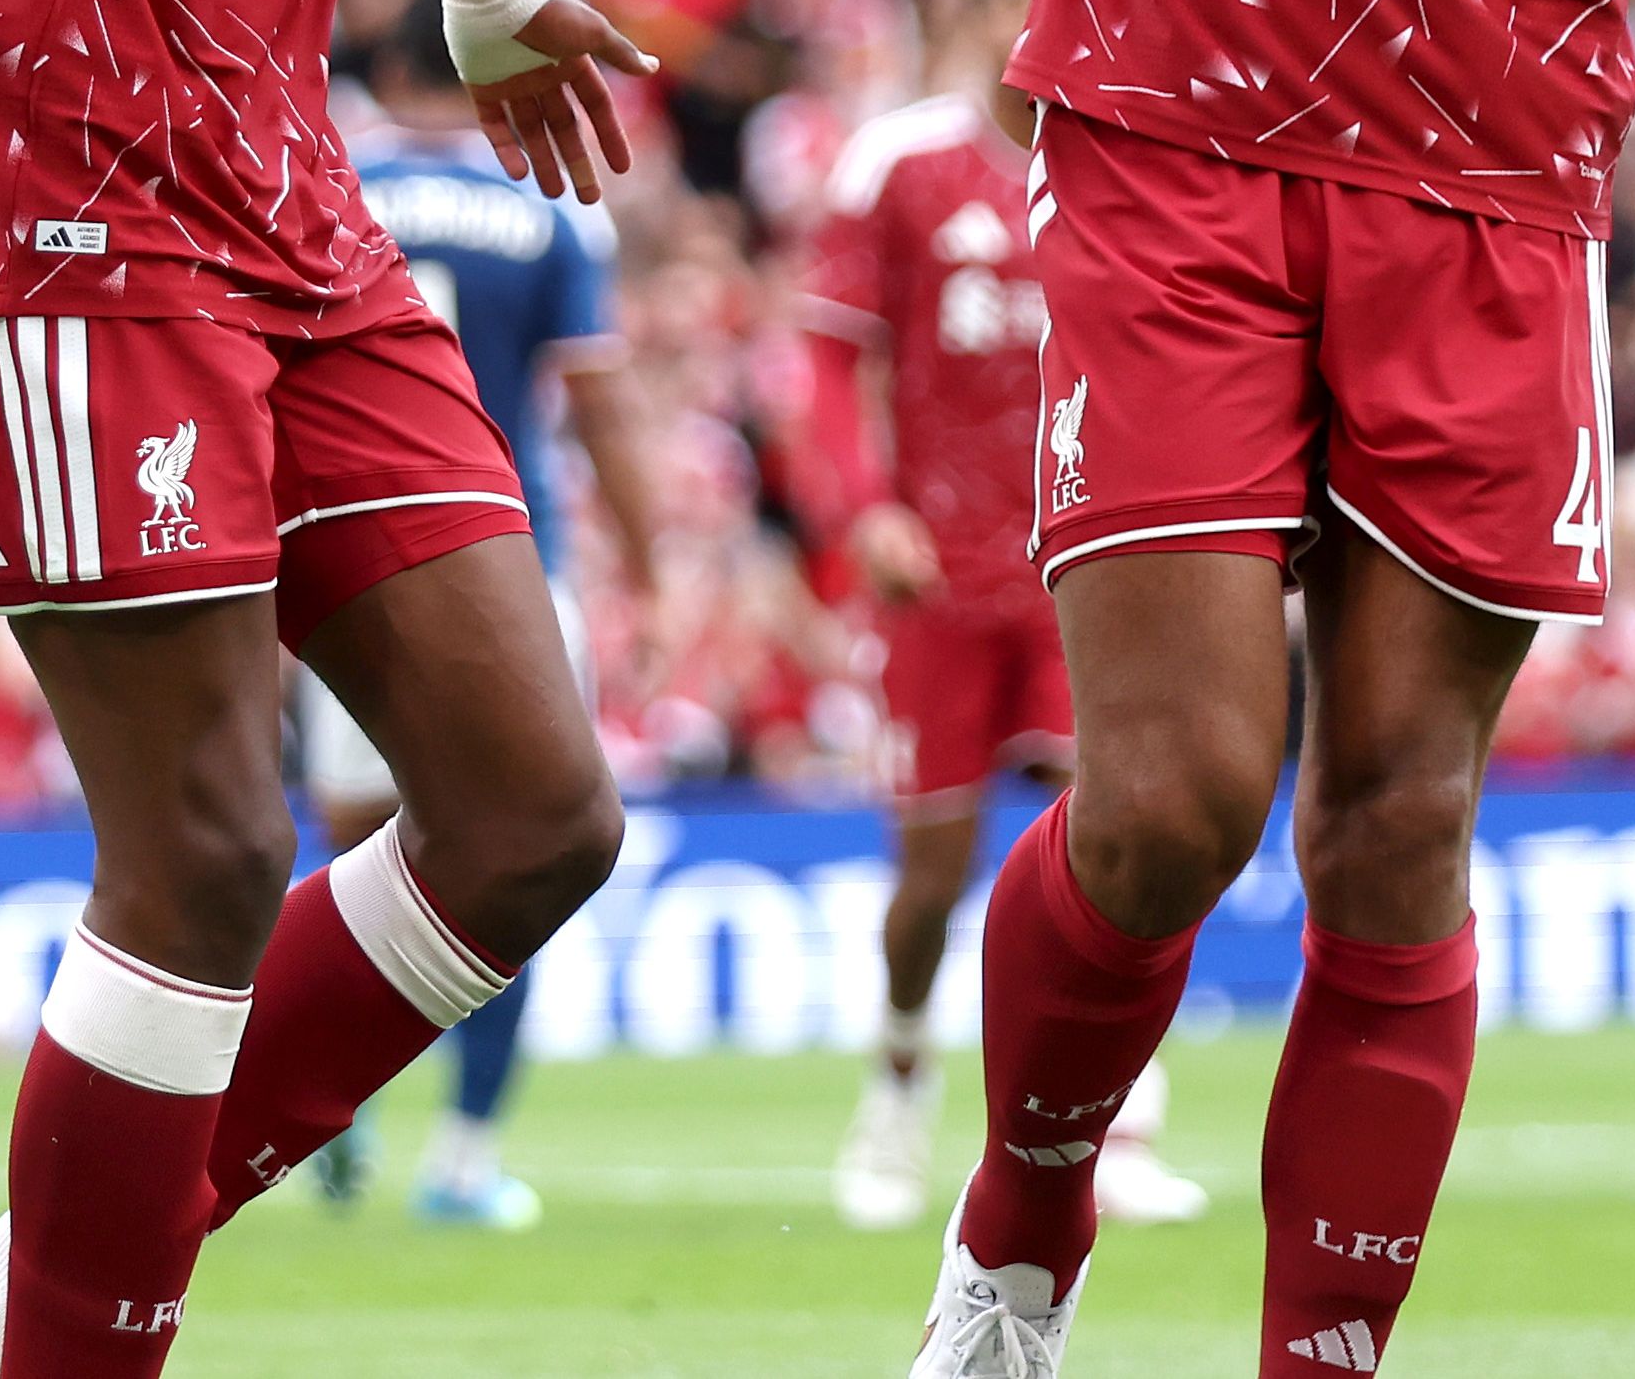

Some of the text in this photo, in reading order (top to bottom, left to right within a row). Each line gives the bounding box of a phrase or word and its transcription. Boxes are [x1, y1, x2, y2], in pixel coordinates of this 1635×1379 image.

[1552, 426, 1602, 583] 4
[139, 524, 207, 556] L.F.C.
[1312, 1217, 1420, 1264] LFC
